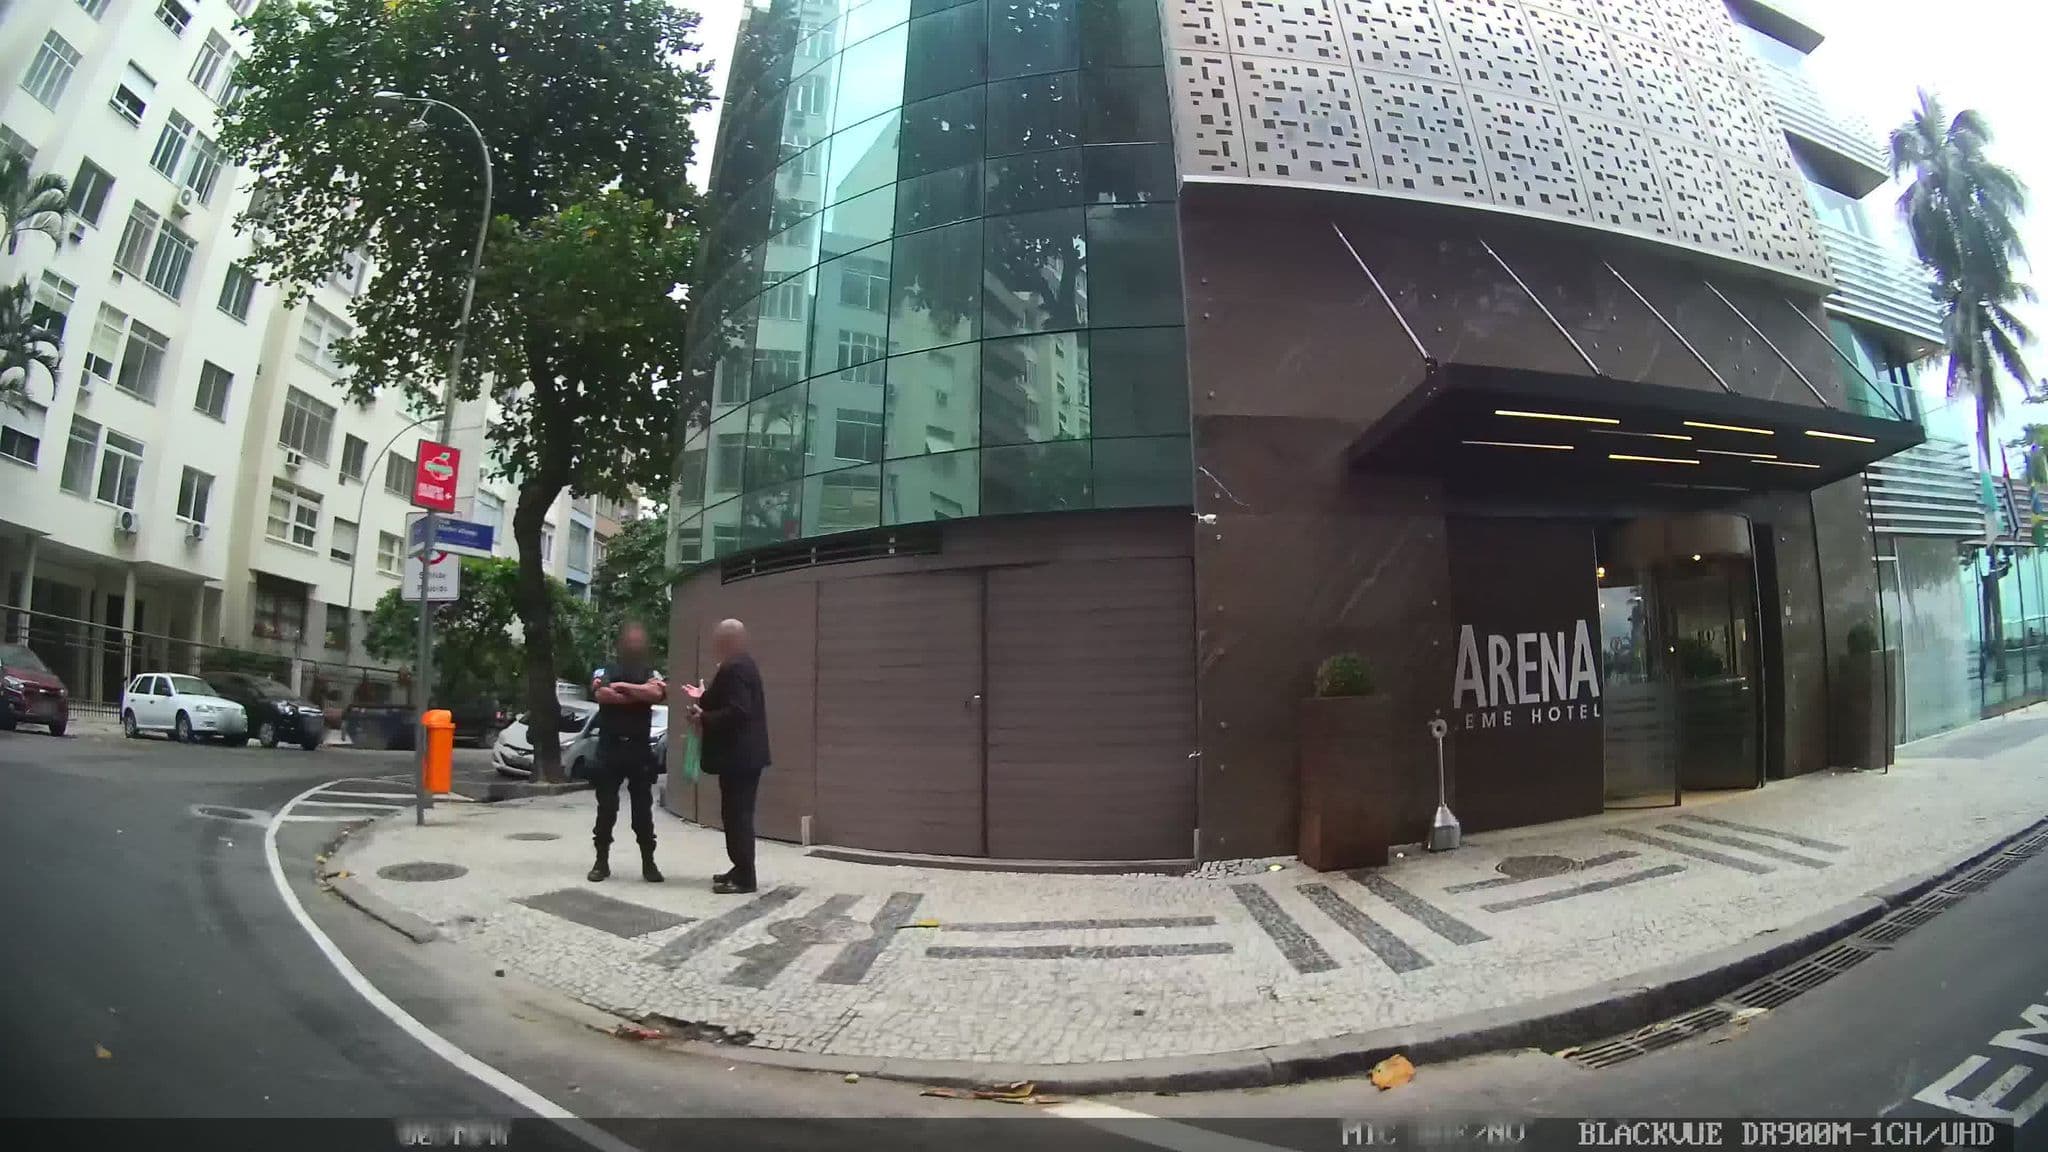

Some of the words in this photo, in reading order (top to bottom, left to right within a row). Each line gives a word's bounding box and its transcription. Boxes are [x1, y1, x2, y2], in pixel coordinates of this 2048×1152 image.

[1453, 619, 1600, 709] ARENA
[1456, 710, 1512, 730] EME
[1531, 703, 1600, 725] HOTEL
